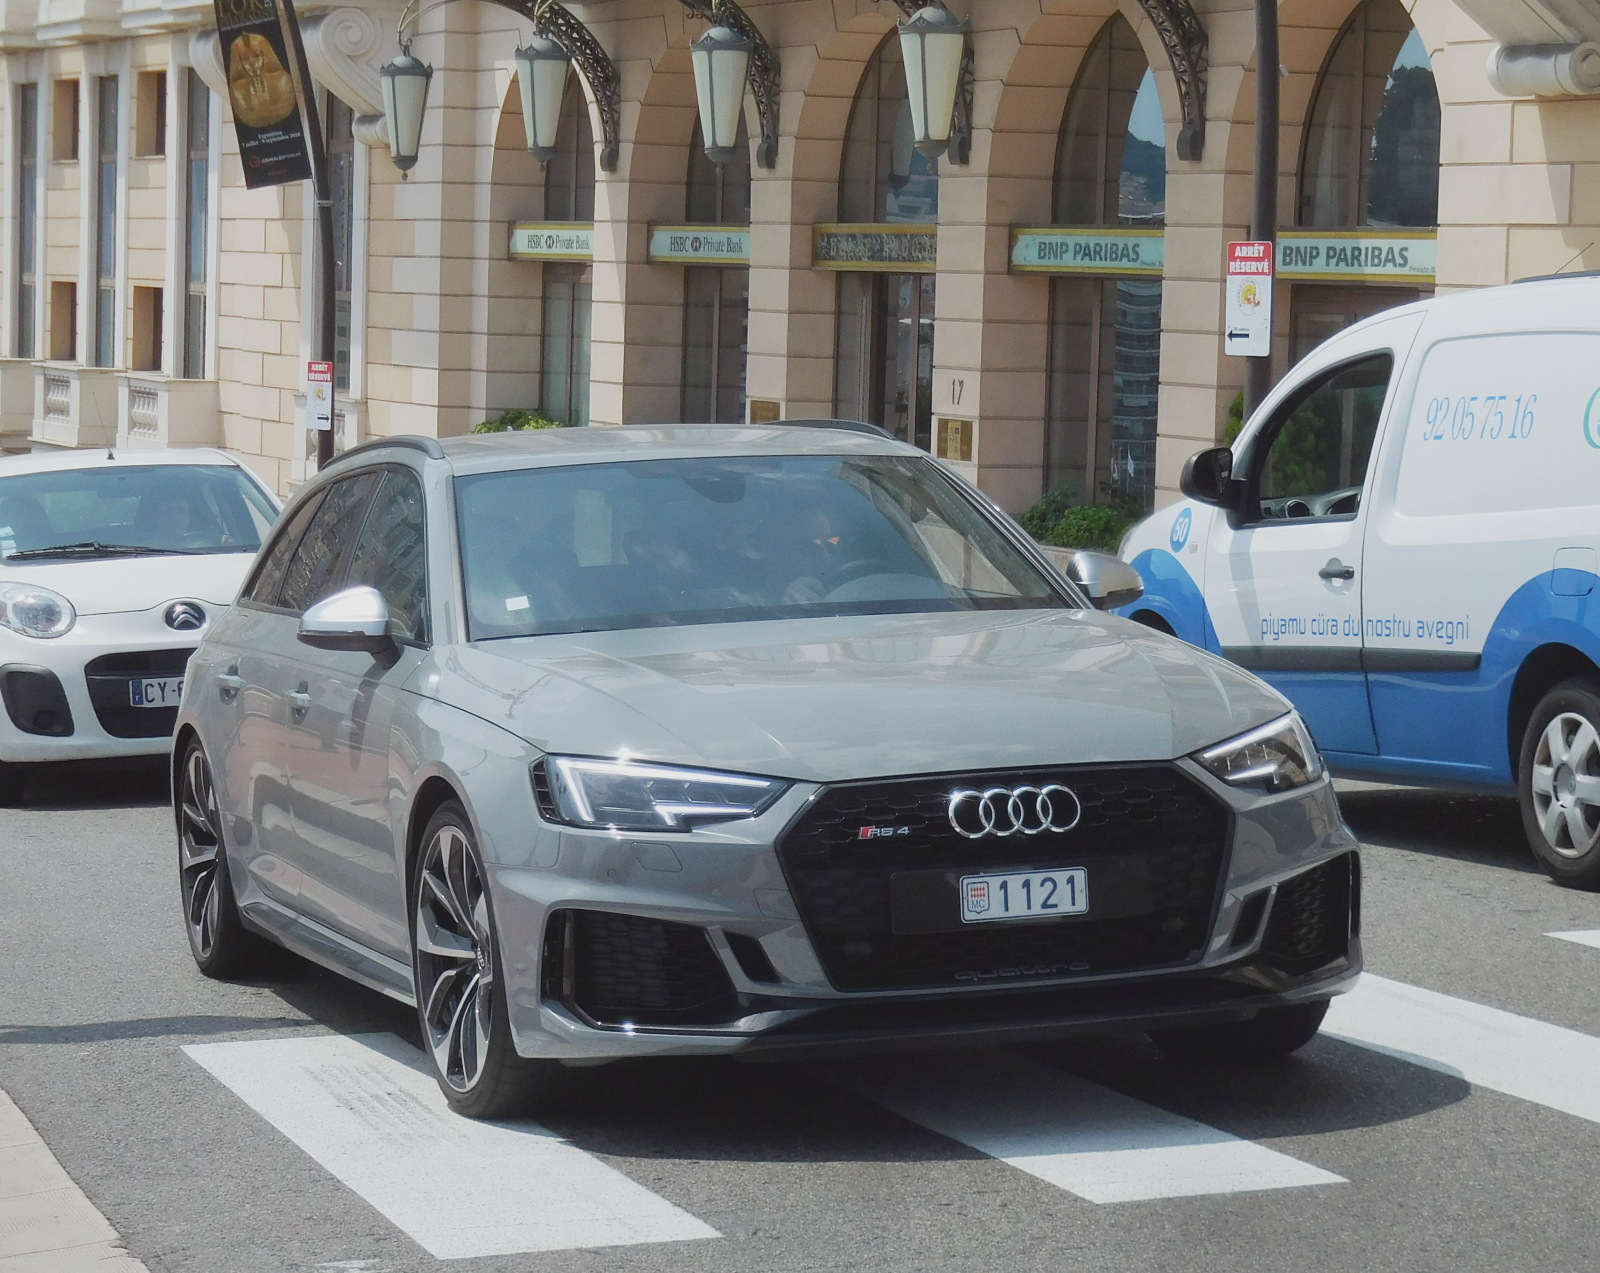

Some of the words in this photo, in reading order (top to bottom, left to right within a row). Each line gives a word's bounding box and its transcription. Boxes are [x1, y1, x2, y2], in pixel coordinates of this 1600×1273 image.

[527, 234, 544, 250] HSBC
[555, 234, 575, 250] Private
[575, 234, 590, 250] Bank
[670, 236, 690, 253] HSBC
[703, 236, 726, 253] Private
[726, 236, 743, 254] Bank
[1037, 241, 1069, 261] BNP
[1072, 242, 1141, 263] PARIBAS
[1234, 243, 1265, 257] ARRÊT
[1229, 259, 1270, 273] RÉSERVÉ
[1281, 245, 1320, 267] BNP
[1325, 246, 1409, 268] PARIBAS
[1423, 396, 1451, 442] 92
[1451, 395, 1479, 441] 05
[1480, 395, 1507, 441] 75
[1508, 393, 1538, 440] 16
[1172, 517, 1189, 543] 50
[1261, 613, 1306, 641] piyamu
[1311, 613, 1339, 636] cüra
[1342, 614, 1360, 637] du
[1366, 614, 1411, 638] nostru
[896, 826, 910, 836] 4
[971, 898, 986, 910] MC
[999, 874, 1076, 913] 1121
[954, 962, 1089, 982] quattro
